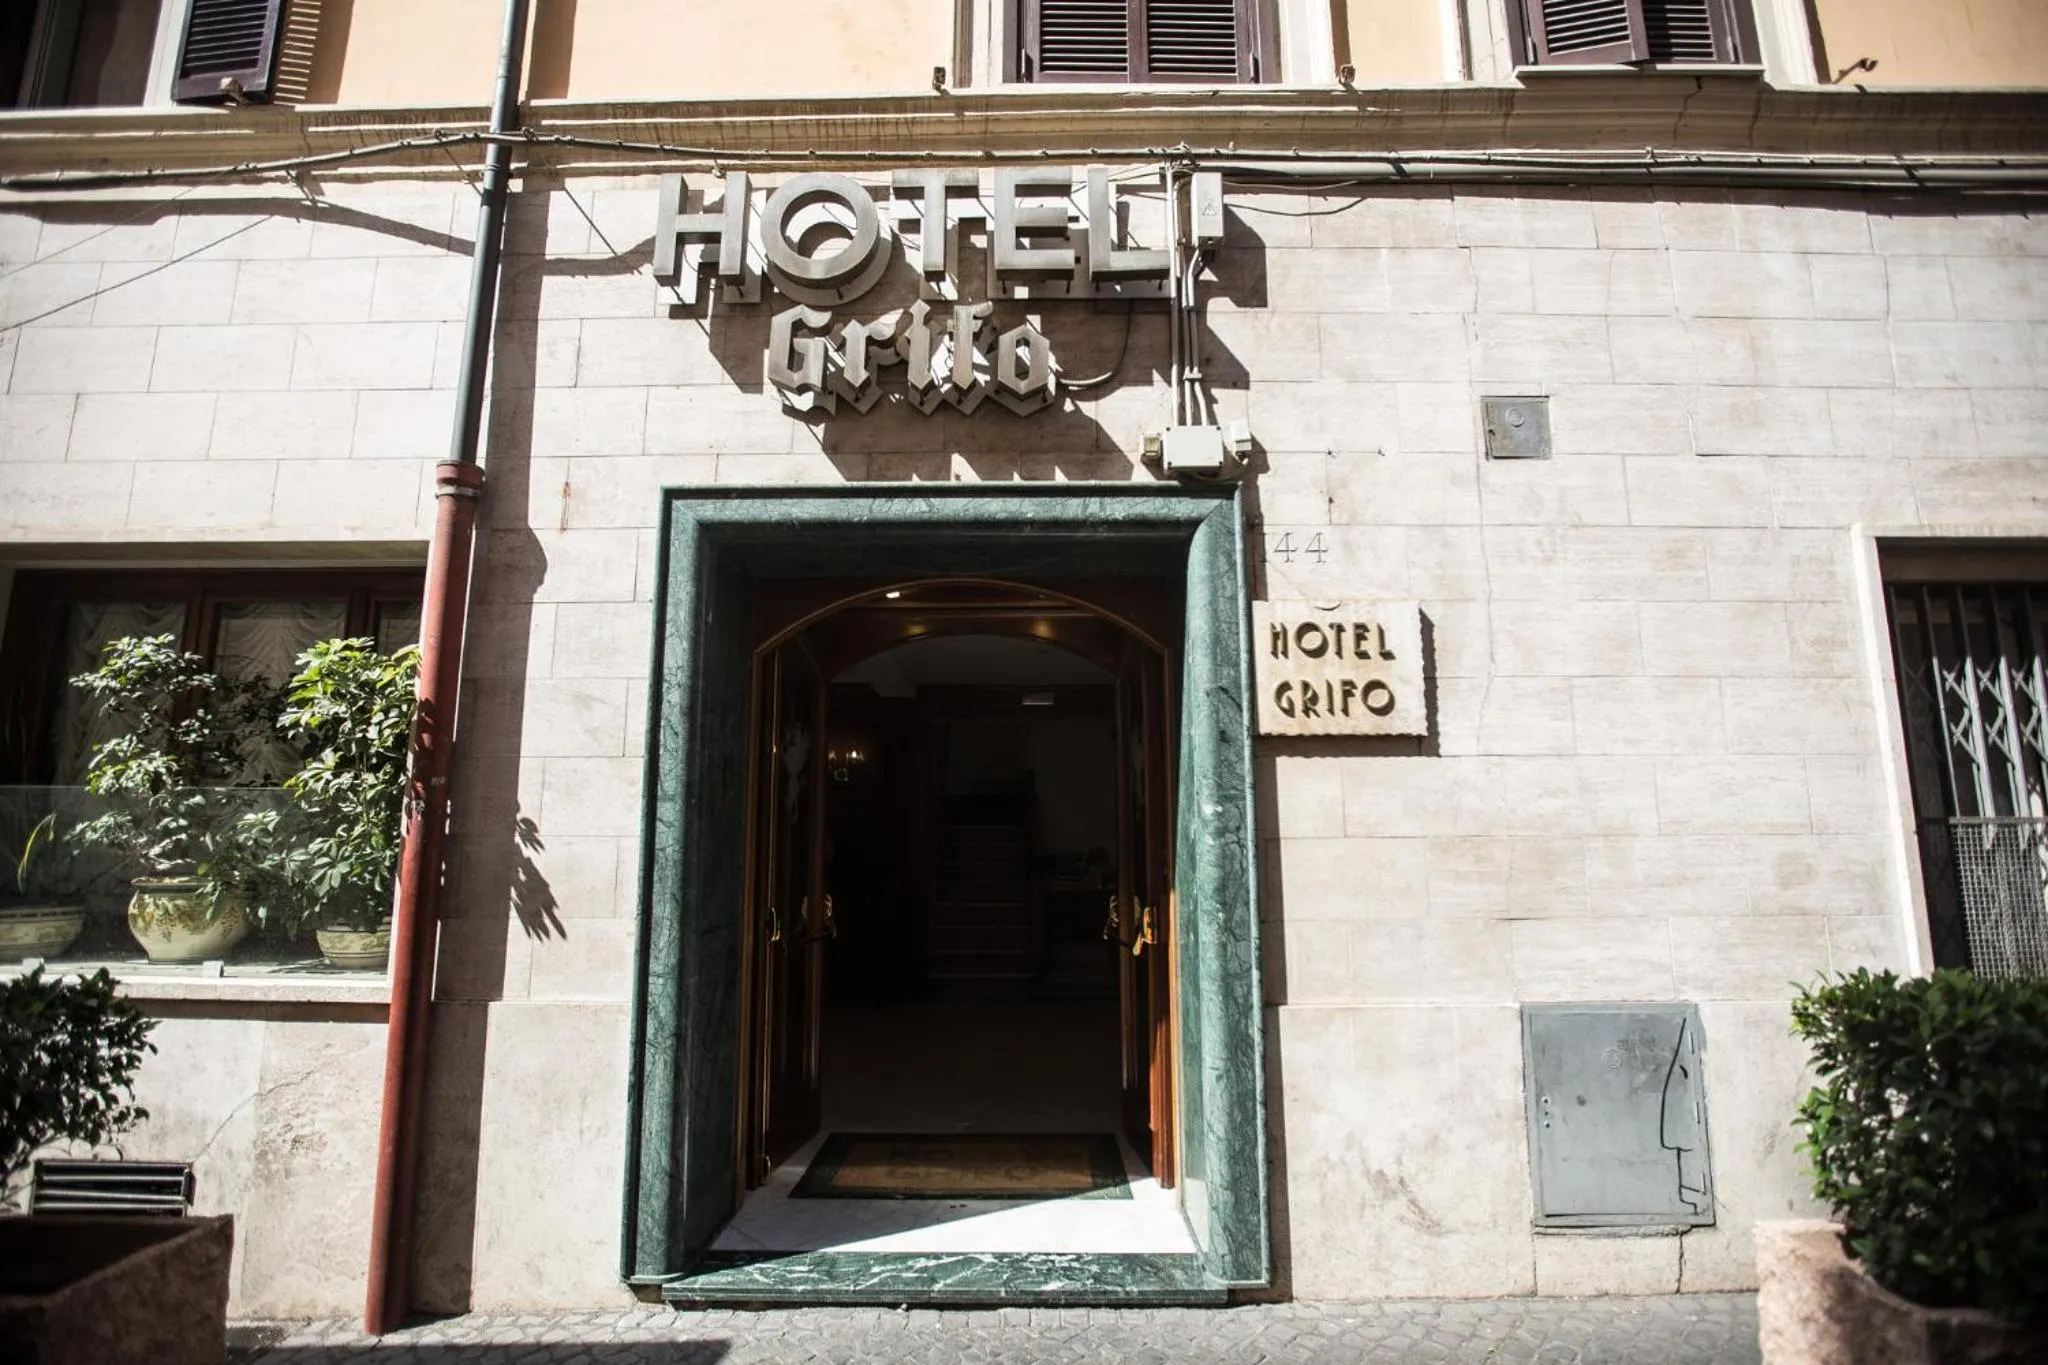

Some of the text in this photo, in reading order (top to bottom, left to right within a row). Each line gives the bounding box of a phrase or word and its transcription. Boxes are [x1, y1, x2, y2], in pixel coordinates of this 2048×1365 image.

[653, 167, 1171, 286] HOTEL
[768, 299, 1050, 395] Grifo
[1270, 621, 1396, 660] HOTEL
[1274, 679, 1396, 719] GRIFO
